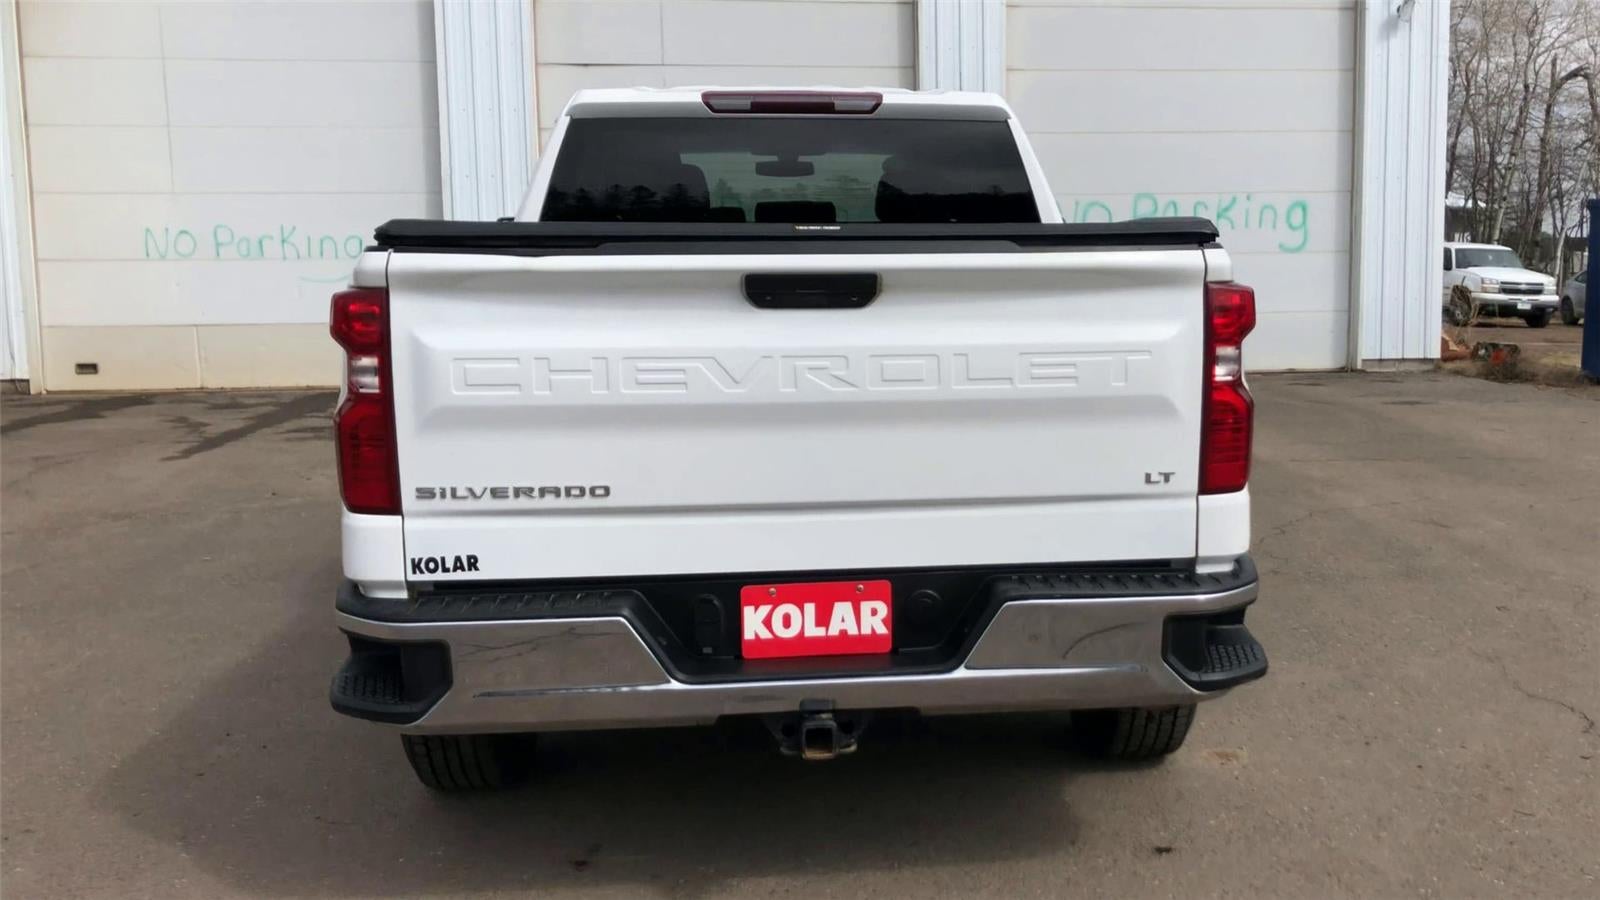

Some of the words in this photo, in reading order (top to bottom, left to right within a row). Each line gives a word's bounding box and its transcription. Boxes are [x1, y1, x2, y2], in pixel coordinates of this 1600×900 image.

[450, 350, 1152, 395] CHEVROLET
[1144, 472, 1176, 484] LT
[410, 554, 480, 575] KOLAR
[743, 600, 889, 640] KOLAR
